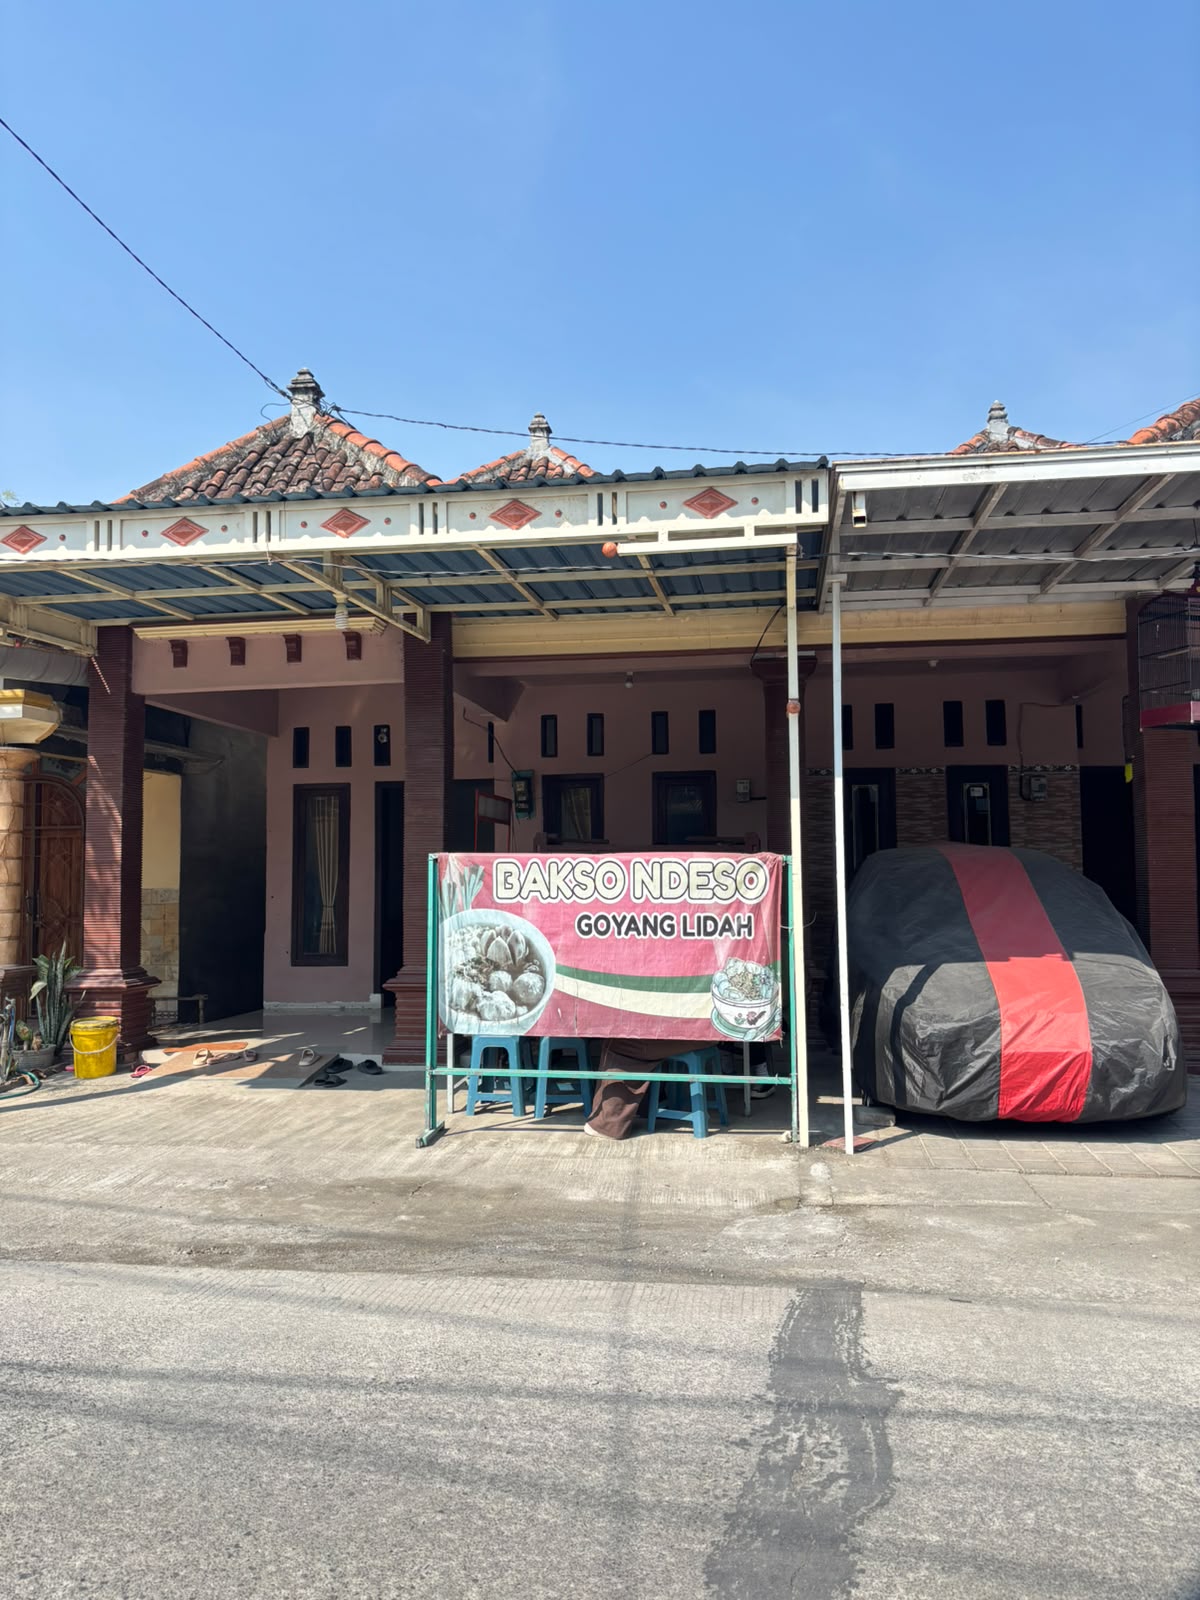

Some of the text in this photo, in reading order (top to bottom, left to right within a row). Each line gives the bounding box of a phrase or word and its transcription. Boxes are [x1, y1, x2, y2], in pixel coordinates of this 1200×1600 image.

[495, 859, 768, 901] BAKSO NDESO
[576, 913, 753, 938] GOYANG LIDAH
